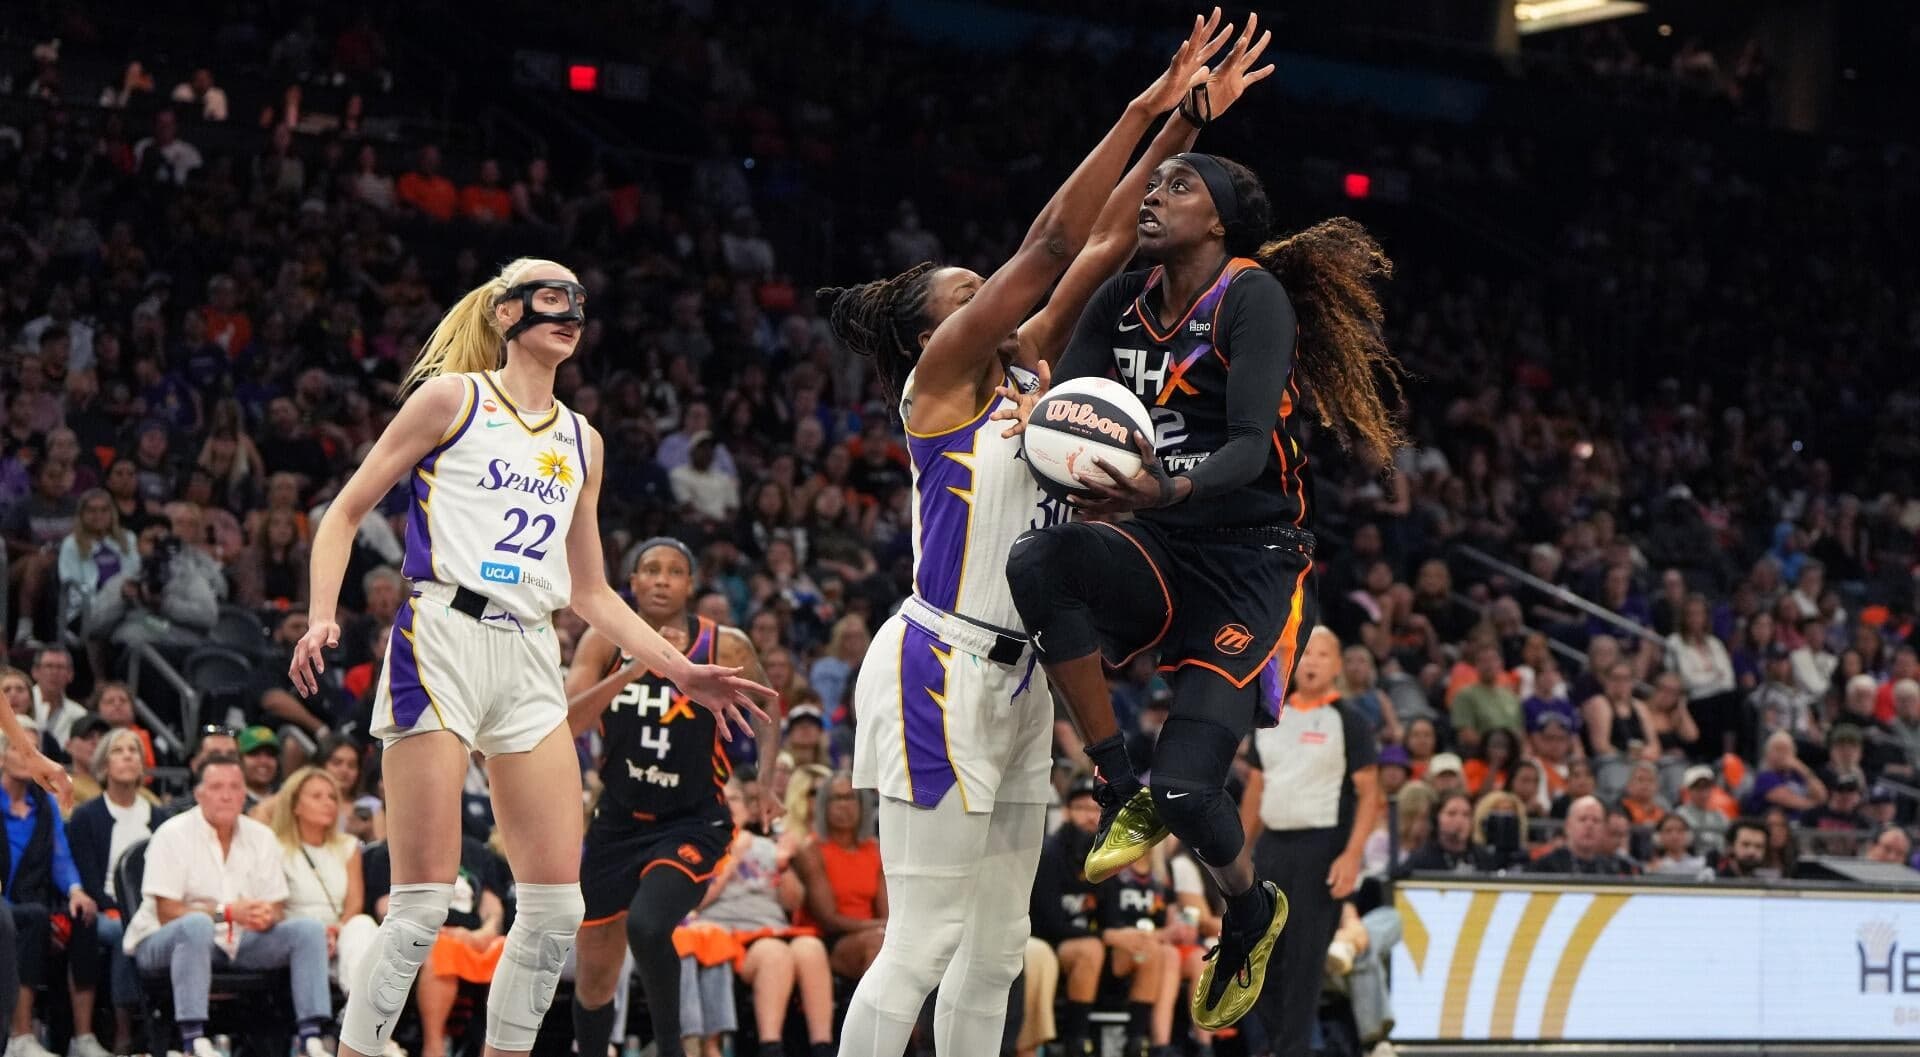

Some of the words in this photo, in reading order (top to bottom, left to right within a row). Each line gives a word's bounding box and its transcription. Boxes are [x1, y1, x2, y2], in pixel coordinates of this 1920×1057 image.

[1189, 319, 1211, 332] HERO
[1113, 344, 1213, 406] PHX
[552, 431, 576, 448] Albert
[1045, 399, 1129, 445] Wilson
[1149, 406, 1190, 449] 2
[493, 506, 557, 562] 22
[485, 565, 516, 581] UCLA
[522, 570, 553, 592] Health
[610, 682, 696, 725] PHX
[640, 725, 672, 760] 4
